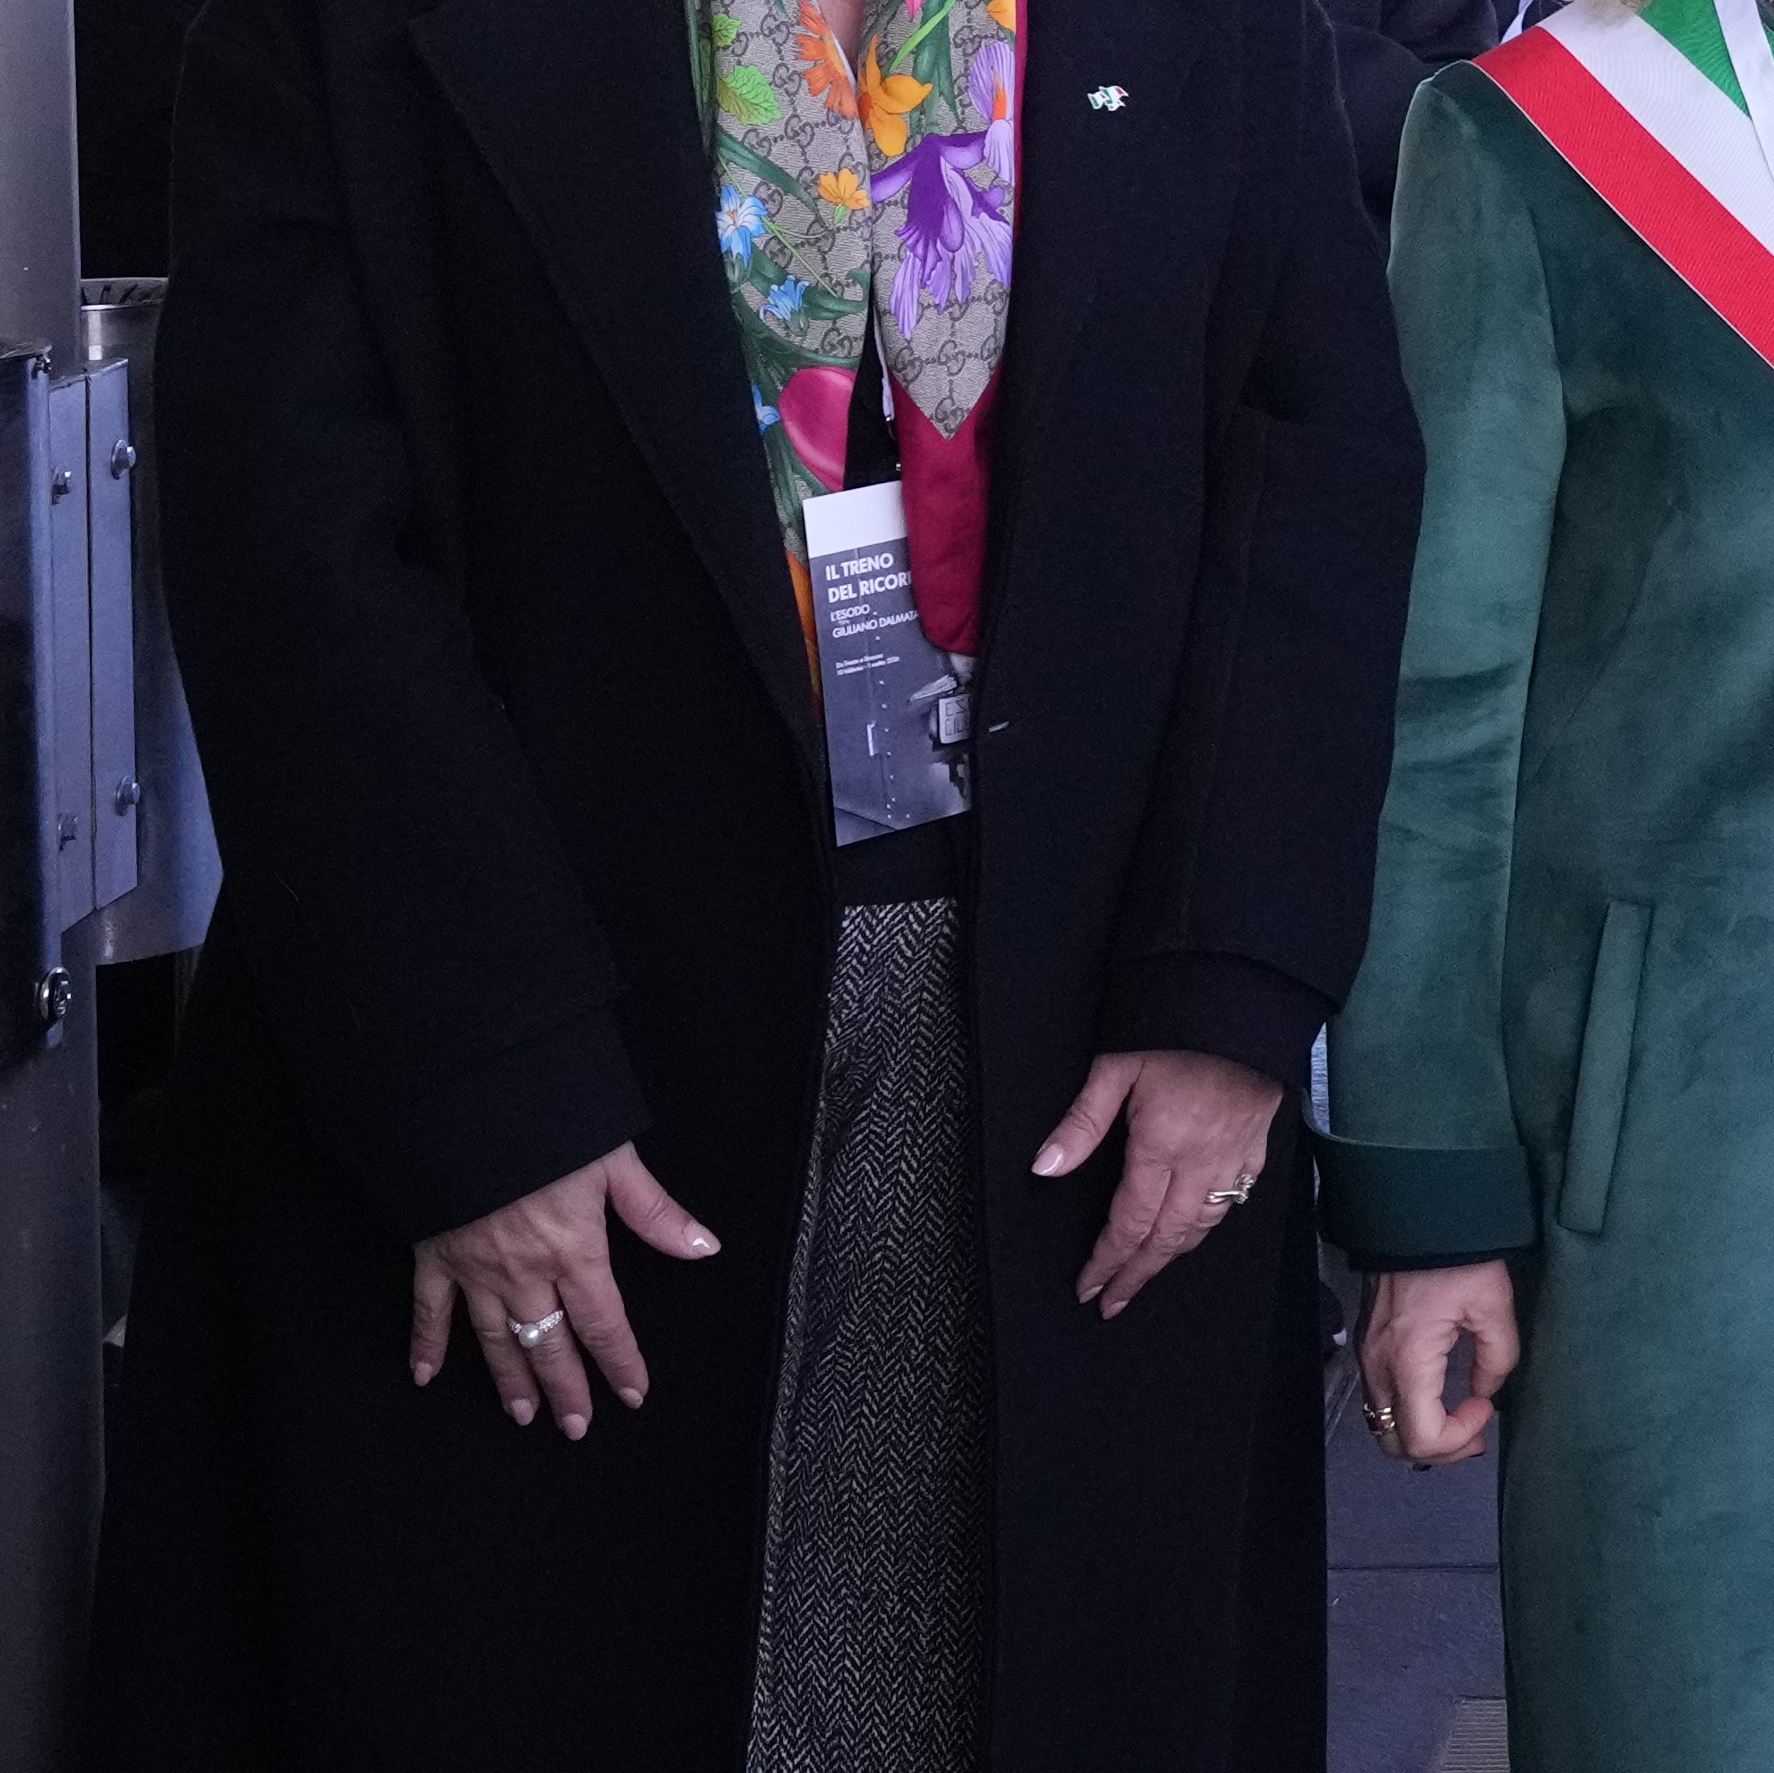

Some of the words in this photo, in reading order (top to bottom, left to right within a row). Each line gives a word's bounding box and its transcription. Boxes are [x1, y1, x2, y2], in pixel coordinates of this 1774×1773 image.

[825, 564, 841, 582] IL
[840, 552, 894, 578] TRENO
[827, 583, 858, 604] DEL
